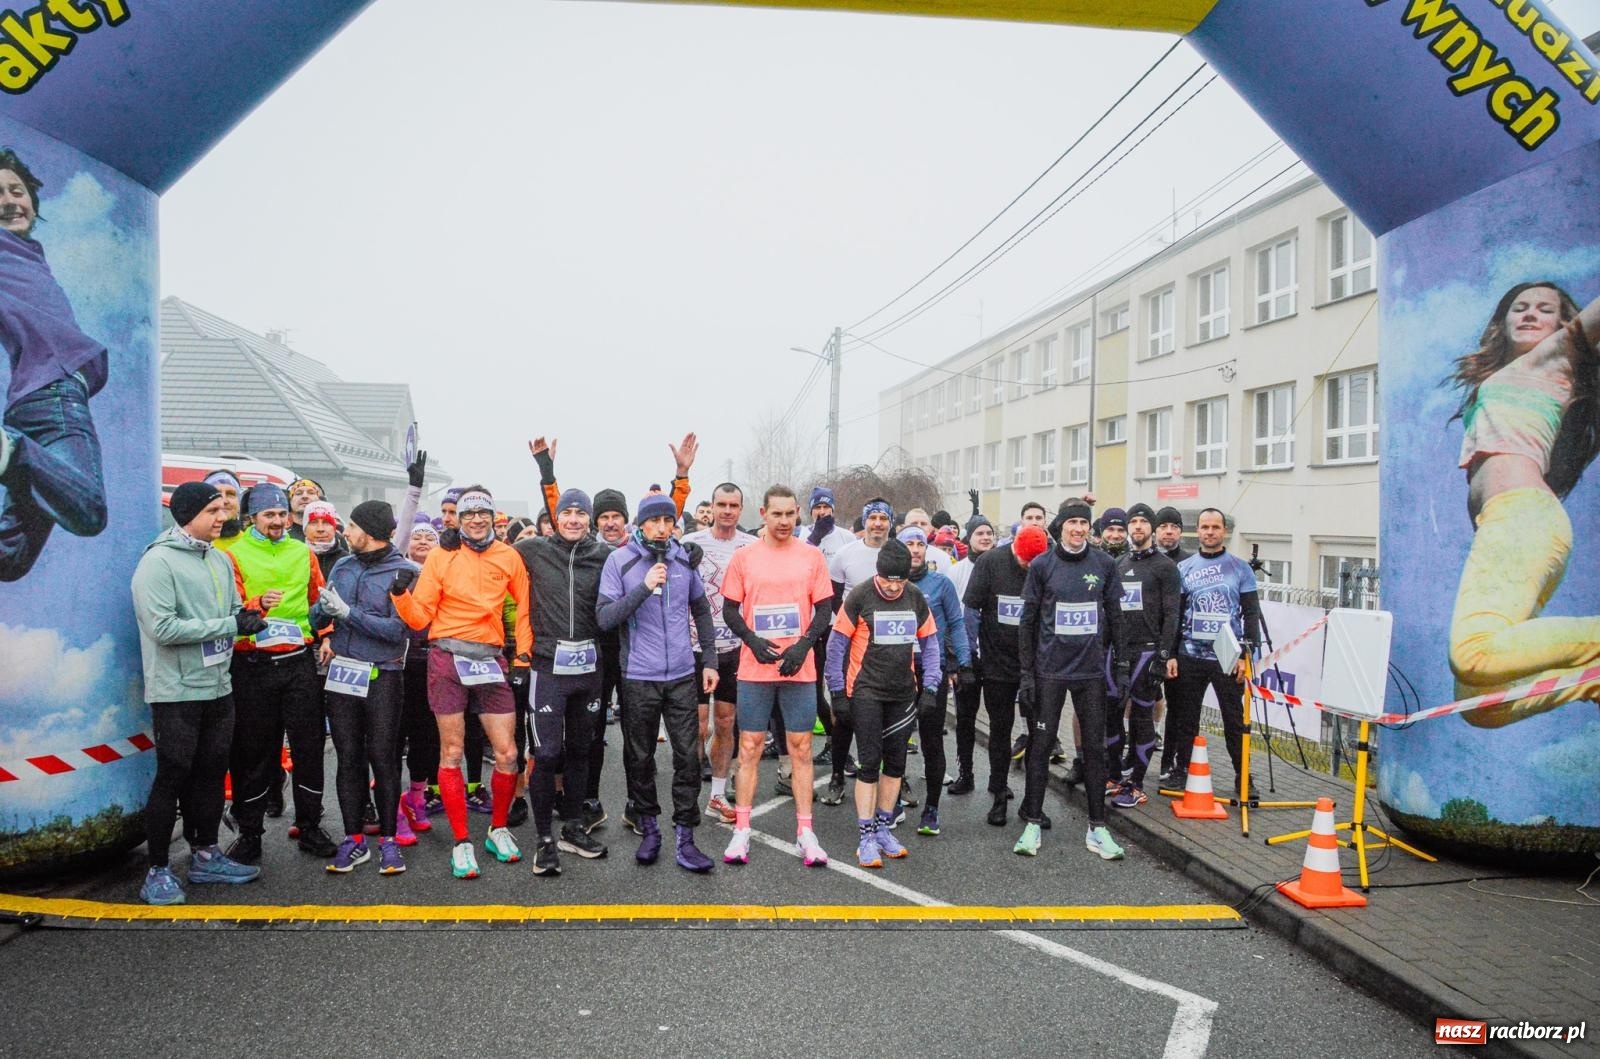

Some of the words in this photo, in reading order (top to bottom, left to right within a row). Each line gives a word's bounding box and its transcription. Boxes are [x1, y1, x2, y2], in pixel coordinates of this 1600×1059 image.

[1368, 0, 1560, 149] wnych
[1184, 563, 1222, 585] MORSY
[766, 614, 787, 629] 12
[1063, 611, 1091, 625] 191
[268, 624, 289, 636] 64
[716, 627, 733, 639] 24
[887, 621, 906, 635] 36
[1202, 620, 1219, 632] 33
[567, 650, 587, 666] 23
[334, 666, 363, 684] 177
